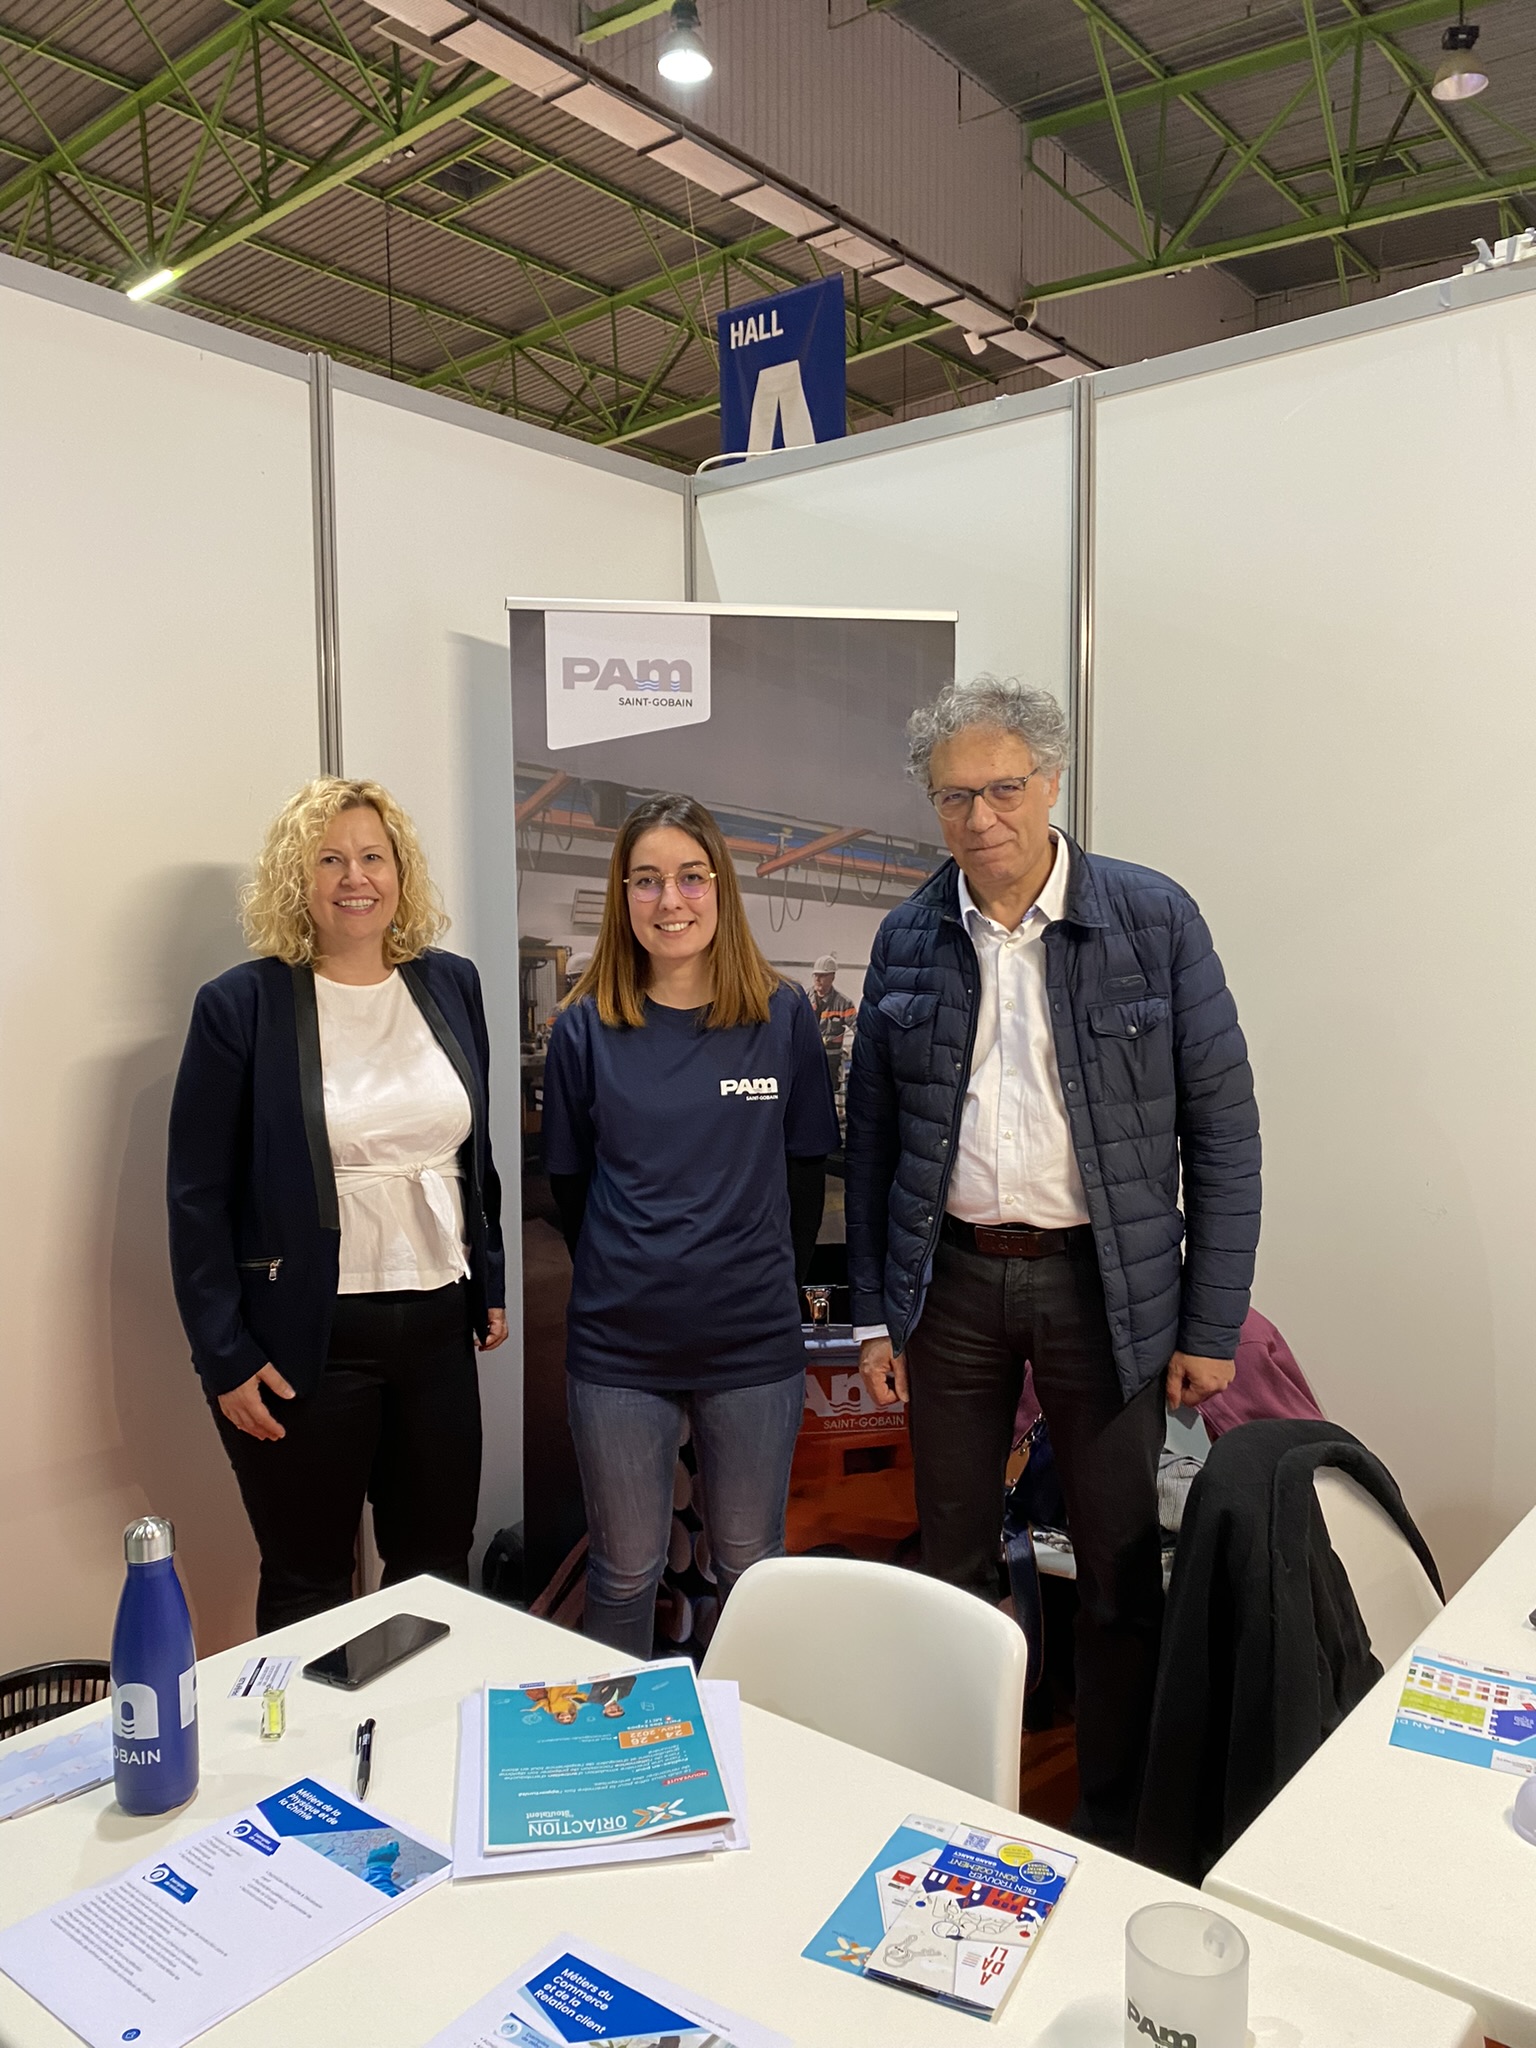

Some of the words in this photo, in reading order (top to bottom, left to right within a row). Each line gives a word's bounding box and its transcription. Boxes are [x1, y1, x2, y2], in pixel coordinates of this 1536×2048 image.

[730, 310, 783, 349] HALL
[746, 360, 816, 464] A
[618, 696, 693, 708] SAINT-GOBAIN
[823, 1416, 904, 1430] SAINT-GOBAIN
[630, 1729, 655, 1738] 2022
[630, 1736, 648, 1745] 26
[665, 1729, 682, 1738] 24
[278, 1797, 287, 1807] la
[286, 1802, 313, 1821] Chimie
[287, 1793, 319, 1816] Physique
[319, 1810, 328, 1820] et
[325, 1815, 339, 1826] de
[296, 1788, 321, 1807] Métiers
[321, 1801, 335, 1812] de
[334, 1809, 342, 1817] la
[528, 1815, 627, 1837] ORIACTION
[953, 1851, 974, 1862] NANCY
[968, 1870, 1016, 1888] TROUVER
[1014, 1885, 1037, 1895] BIEN
[561, 1967, 599, 1991] Métiers
[598, 1985, 614, 2002] du
[980, 1971, 992, 1986] A
[543, 1982, 556, 1995] et
[554, 1987, 569, 2001] de
[568, 1995, 581, 2007] la
[552, 1975, 608, 2011] Commerce
[534, 1989, 575, 2018] Relation
[574, 2011, 606, 2035] client
